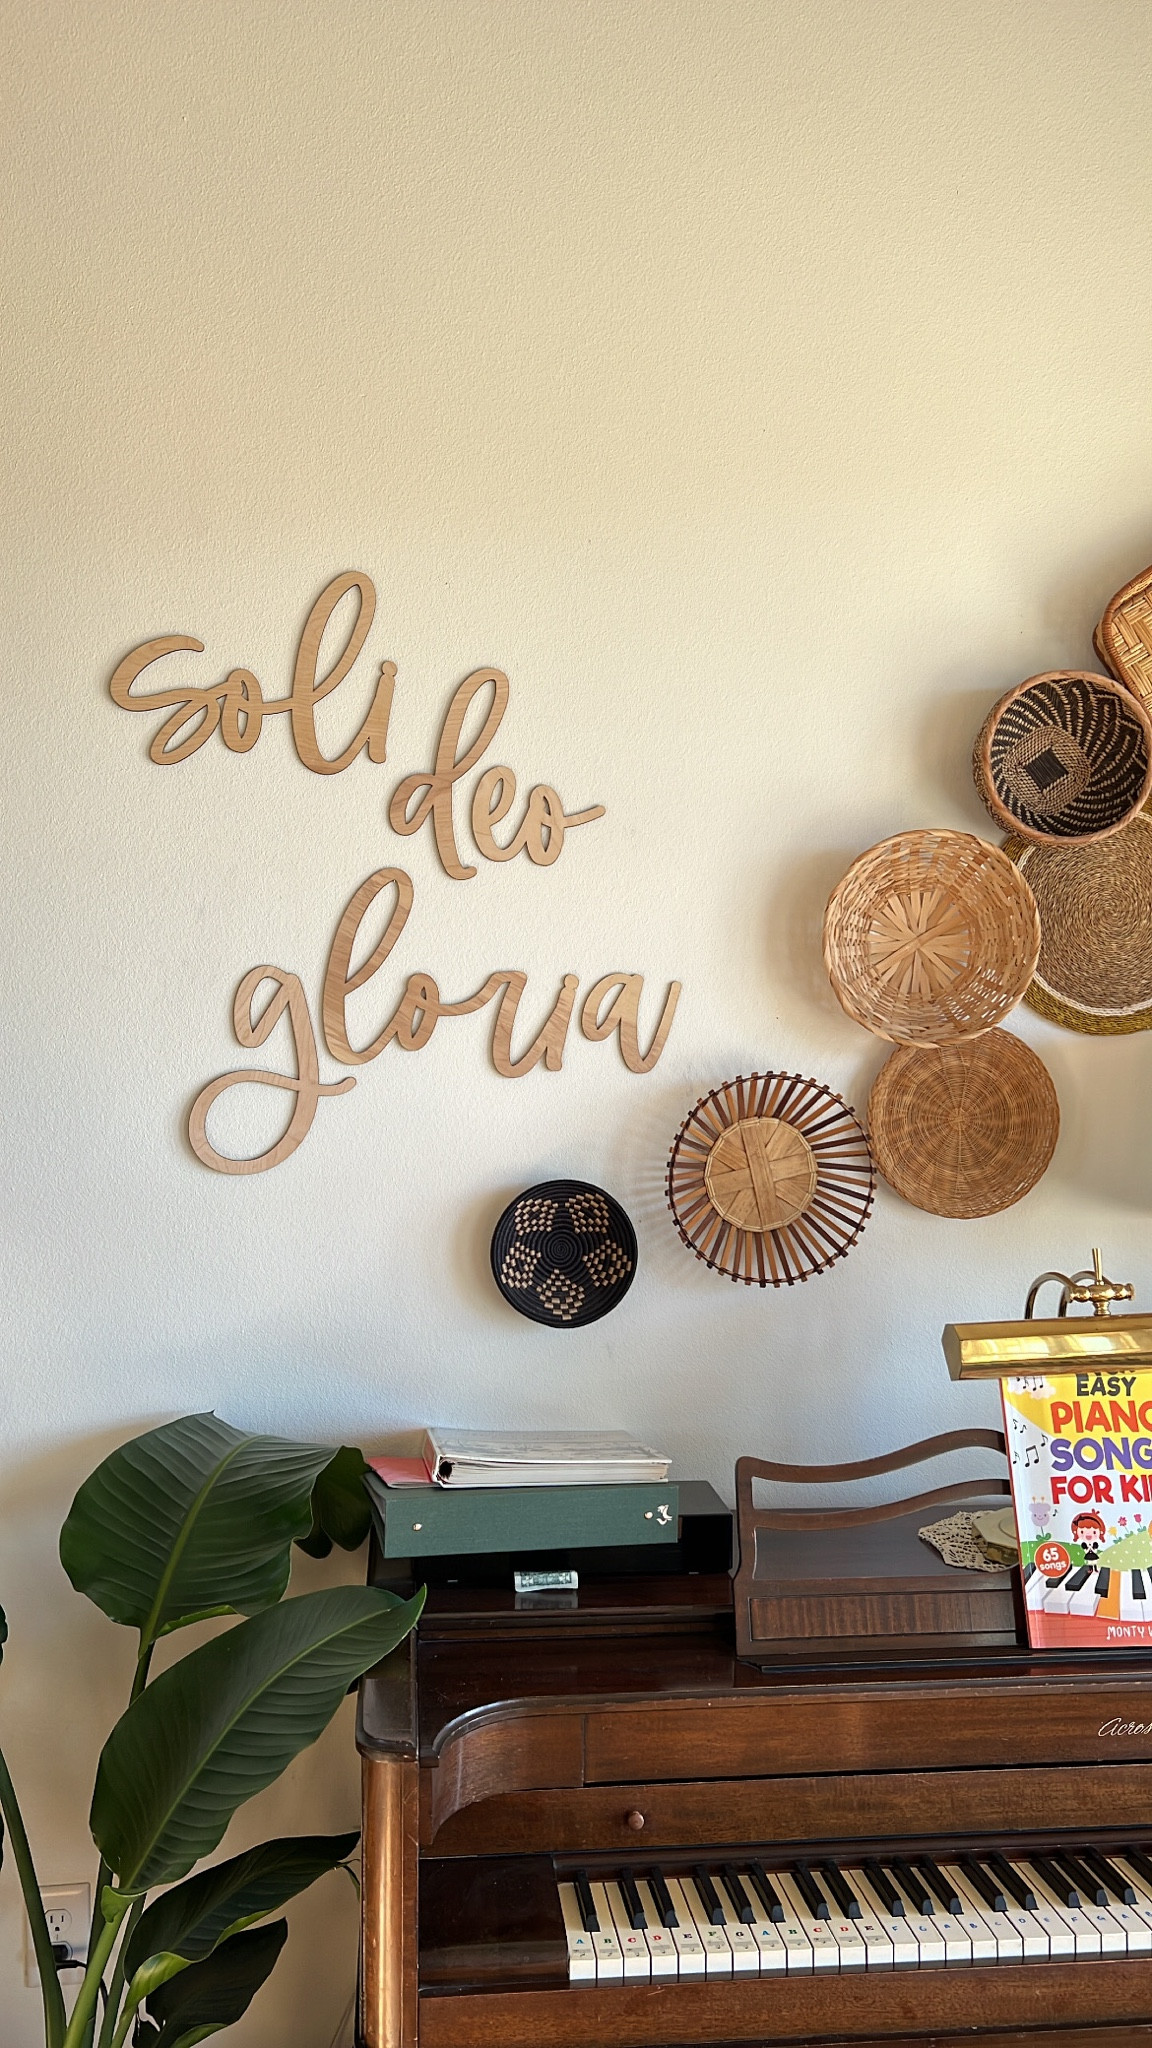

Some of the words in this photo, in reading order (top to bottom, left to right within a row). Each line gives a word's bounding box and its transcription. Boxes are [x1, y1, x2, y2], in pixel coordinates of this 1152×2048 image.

[110, 571, 397, 775] soli
[389, 668, 606, 880] deo
[188, 867, 682, 1175] gloria
[1076, 1376, 1137, 1396] EASY
[1050, 1475, 1114, 1504] FOR
[1119, 1474, 1152, 1503] KI
[1040, 1561, 1067, 1571] songs
[1043, 1547, 1059, 1562] 65
[1106, 1625, 1145, 1640] MONTY
